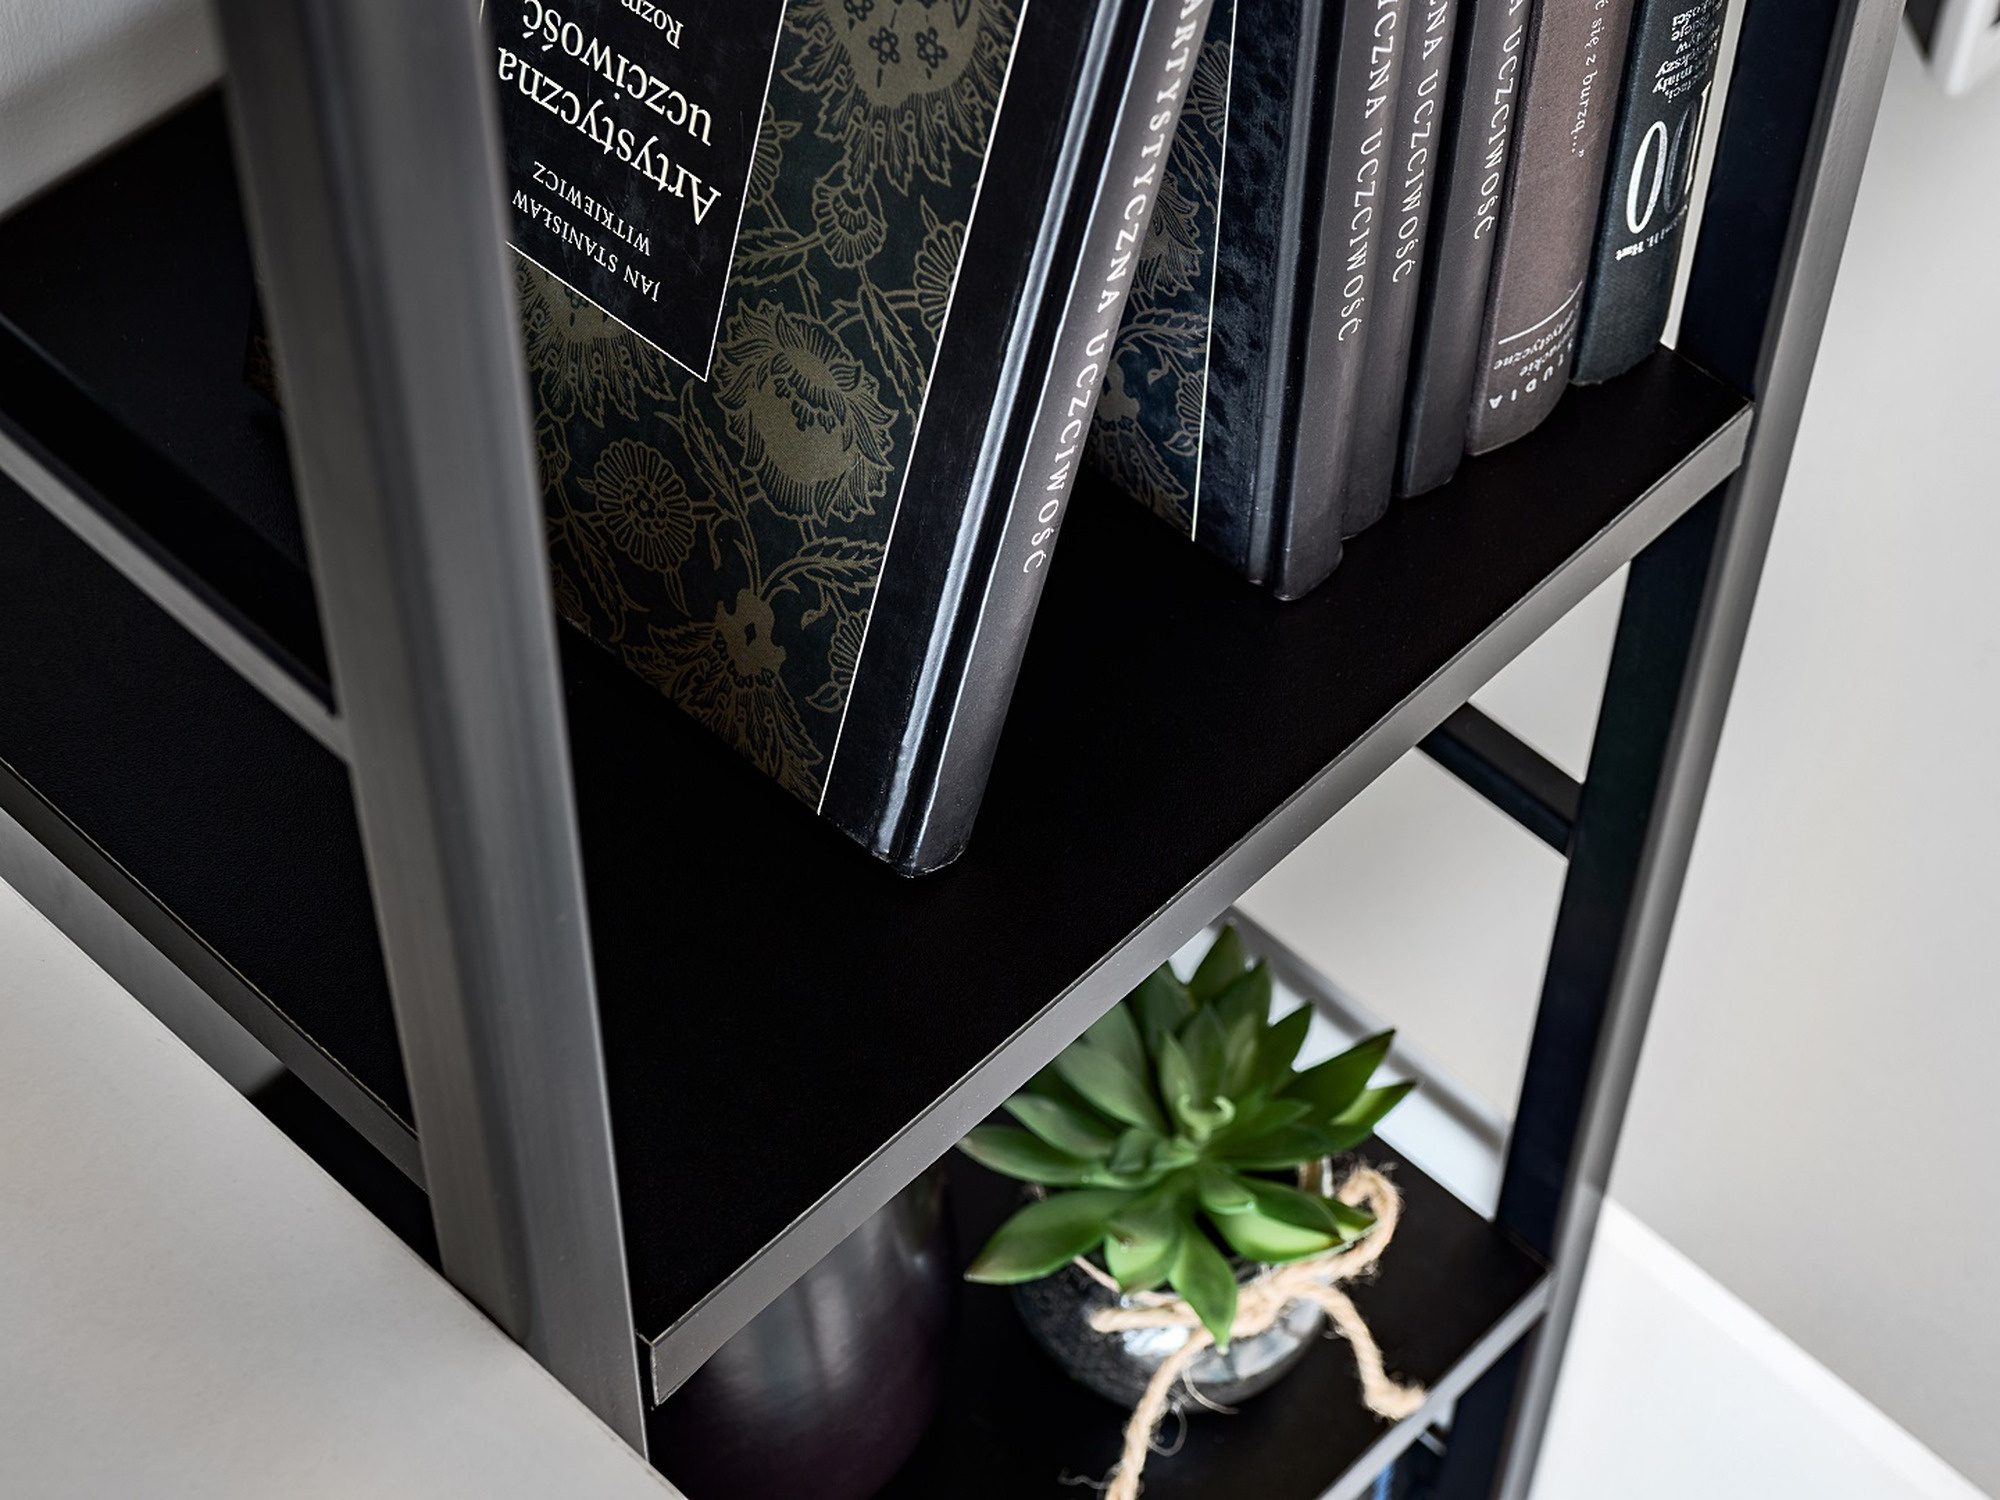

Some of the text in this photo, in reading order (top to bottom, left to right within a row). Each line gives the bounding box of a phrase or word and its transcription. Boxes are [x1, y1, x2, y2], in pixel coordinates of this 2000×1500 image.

[522, 0, 711, 147] uczciwość
[1584, 17, 1606, 50] się
[1585, 53, 1597, 67] z
[498, 47, 722, 226] Artystyczna
[532, 160, 651, 256] WITKIEWICZ
[1392, 0, 1449, 283] NA UCZCIWOŚĆ
[1473, 23, 1524, 240] UCZCIWOŚĆ
[512, 189, 661, 302] JAN STANISŁAW
[1023, 0, 1204, 574] ARTYSTYCZNA UCZCIWOŚĆ
[1337, 126, 1384, 342] UCZCIWOŚĆ
